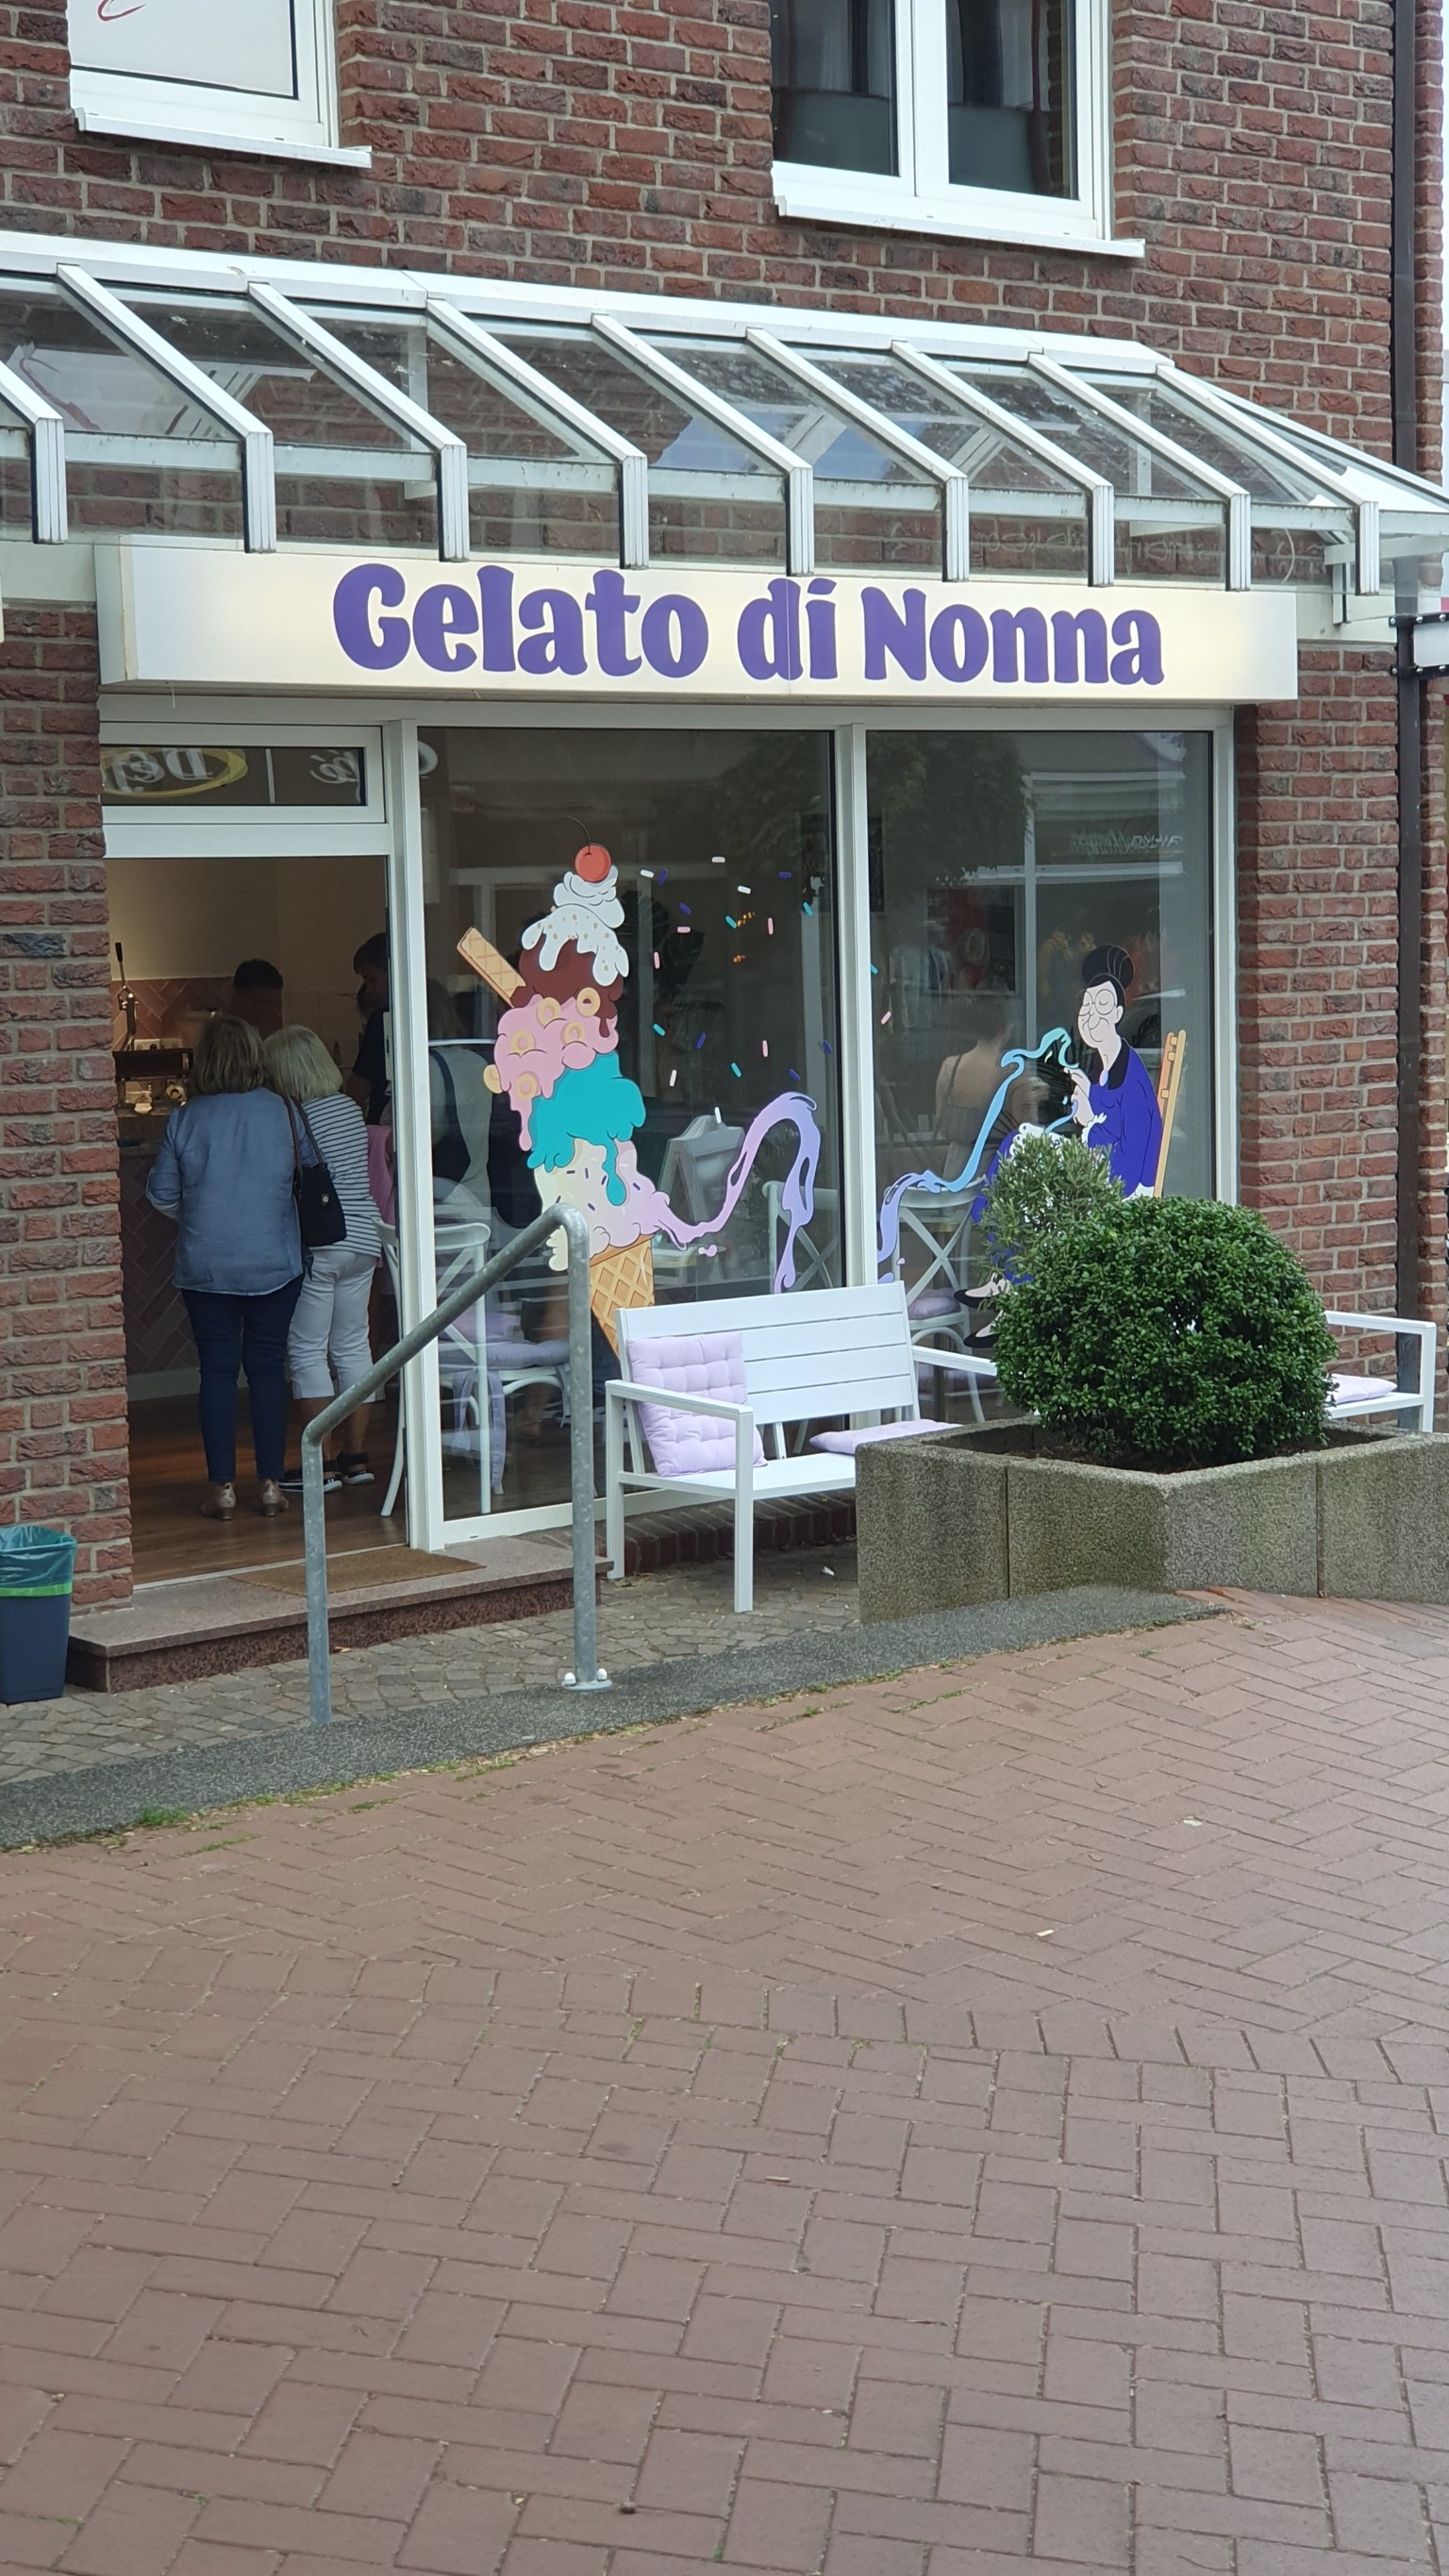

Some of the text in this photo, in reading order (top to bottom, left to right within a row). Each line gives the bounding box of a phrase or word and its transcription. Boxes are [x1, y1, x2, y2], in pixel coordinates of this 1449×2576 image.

[334, 562, 1163, 685] Gelato di Nonna
